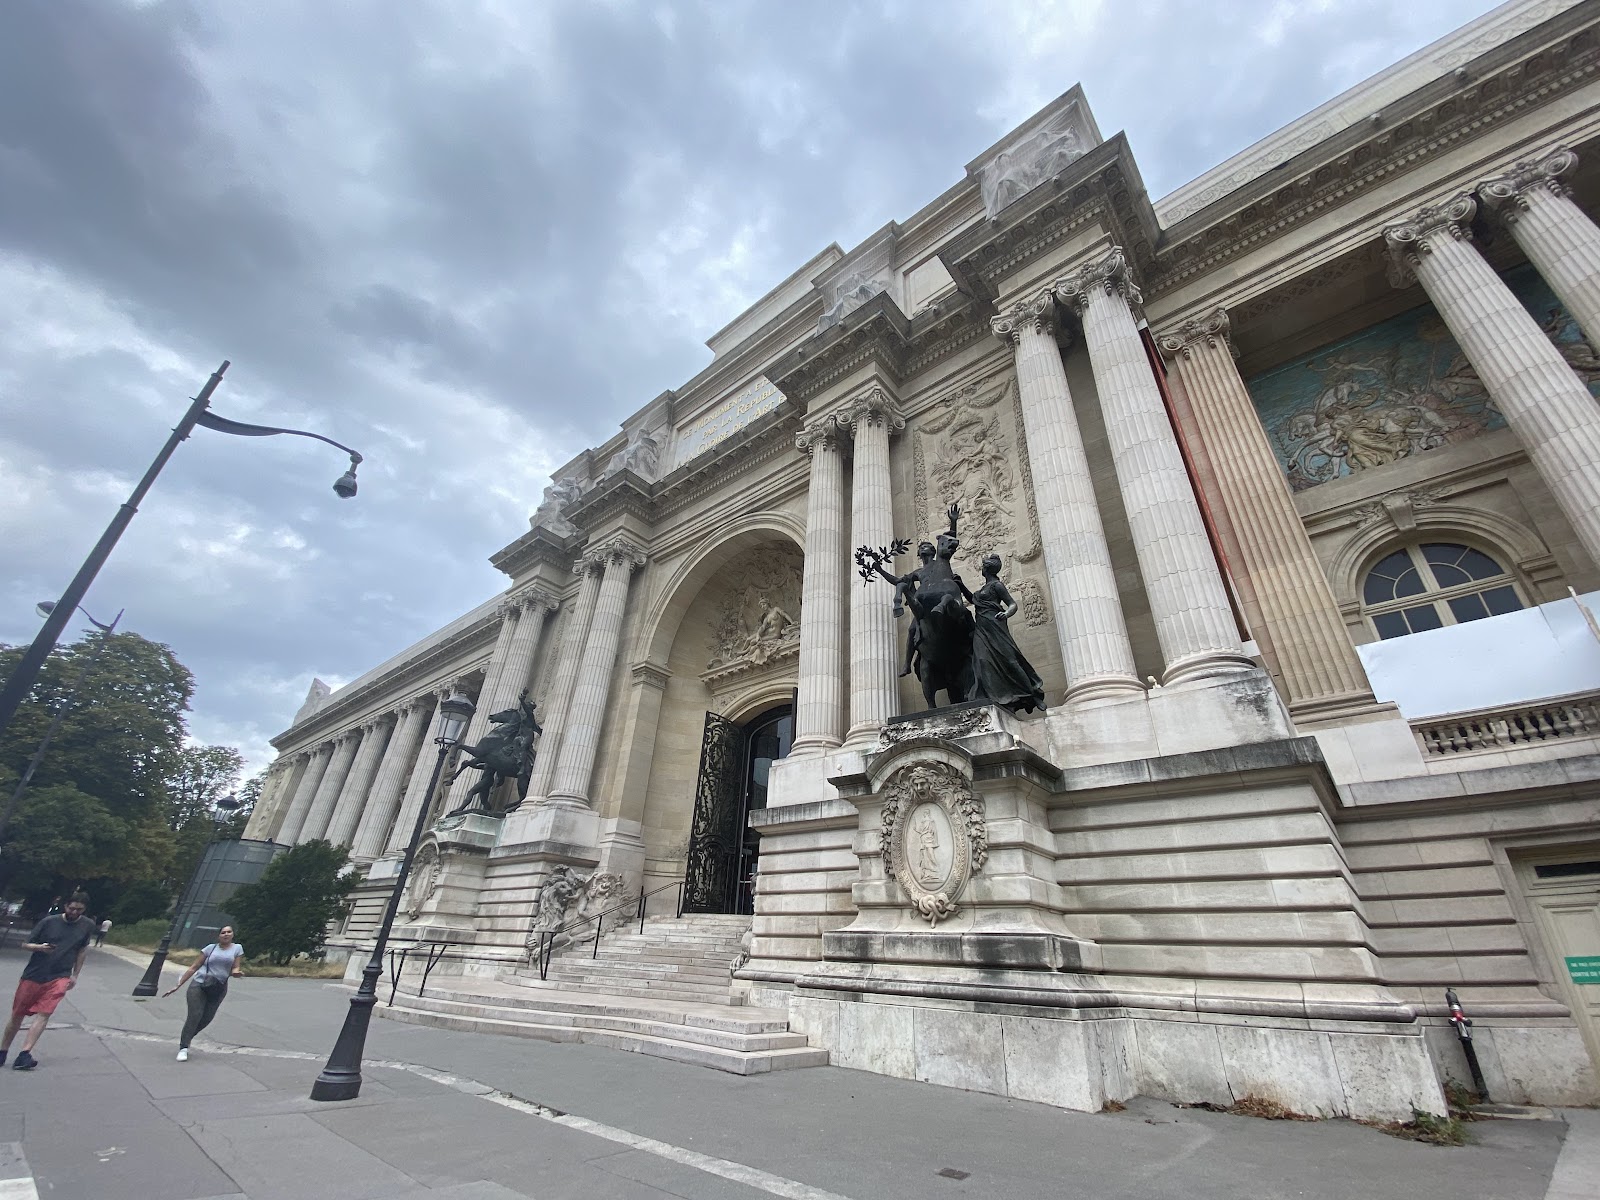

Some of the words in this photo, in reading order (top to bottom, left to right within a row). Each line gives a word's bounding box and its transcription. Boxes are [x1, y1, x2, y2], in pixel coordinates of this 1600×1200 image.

[694, 393, 745, 433] MONUMENT
[702, 424, 718, 440] PAR
[721, 415, 732, 427] LA
[732, 420, 744, 432] DE
